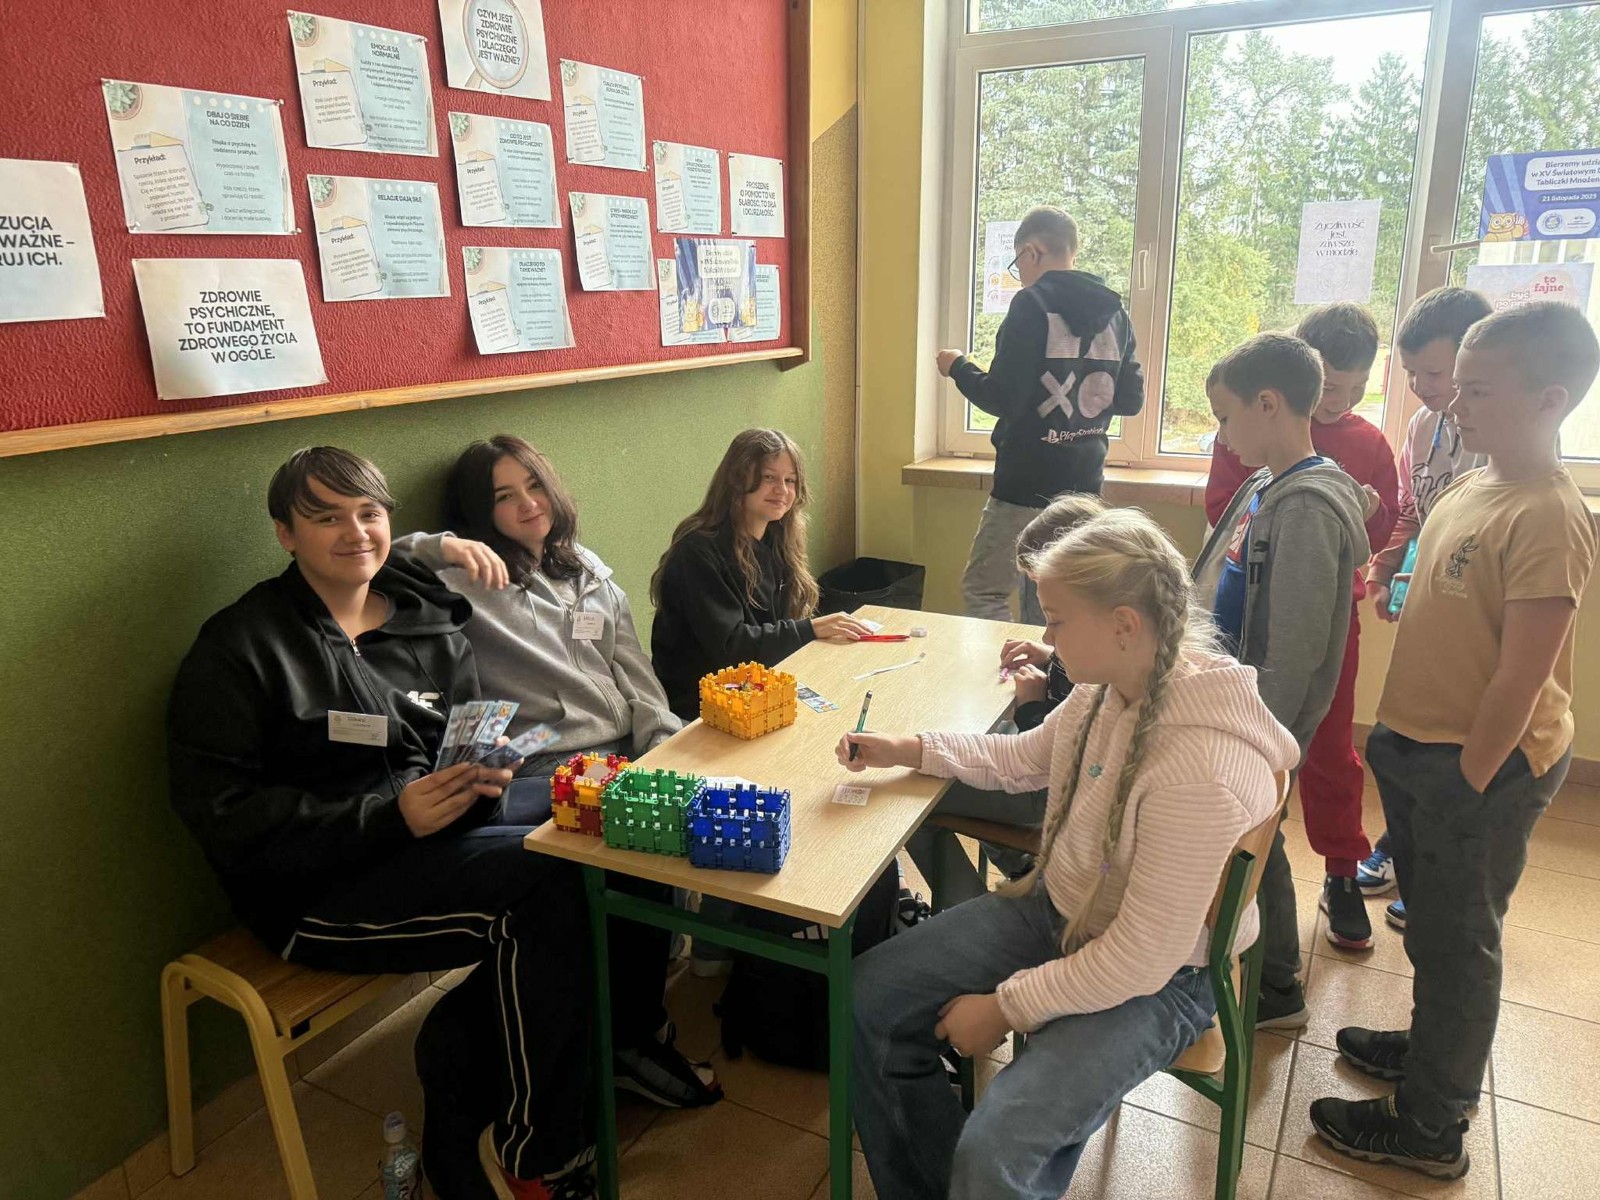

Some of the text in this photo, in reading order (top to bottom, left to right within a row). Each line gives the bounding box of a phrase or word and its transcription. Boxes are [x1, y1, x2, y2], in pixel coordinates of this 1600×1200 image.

[477, 8, 512, 24] CZYM JEST
[481, 20, 512, 34] ZDROWIE
[476, 28, 518, 44] PSYCHICZNE
[482, 40, 517, 54] DLACZEGO
[478, 50, 492, 60] JEST
[1552, 168, 1596, 176] Światowym
[0, 216, 53, 230] ZUCIA
[0, 230, 64, 248] WAŻNE
[27, 252, 62, 266] ICH.
[1534, 283, 1564, 294] fajne
[200, 290, 262, 303] ZDROWIE
[190, 305, 275, 319] PSYCHICZNE,
[184, 319, 284, 334] TO FUNDAMENT
[178, 331, 298, 351] ZDROWEGO ŻYCIA
[211, 346, 275, 364] W OGÓLE.
